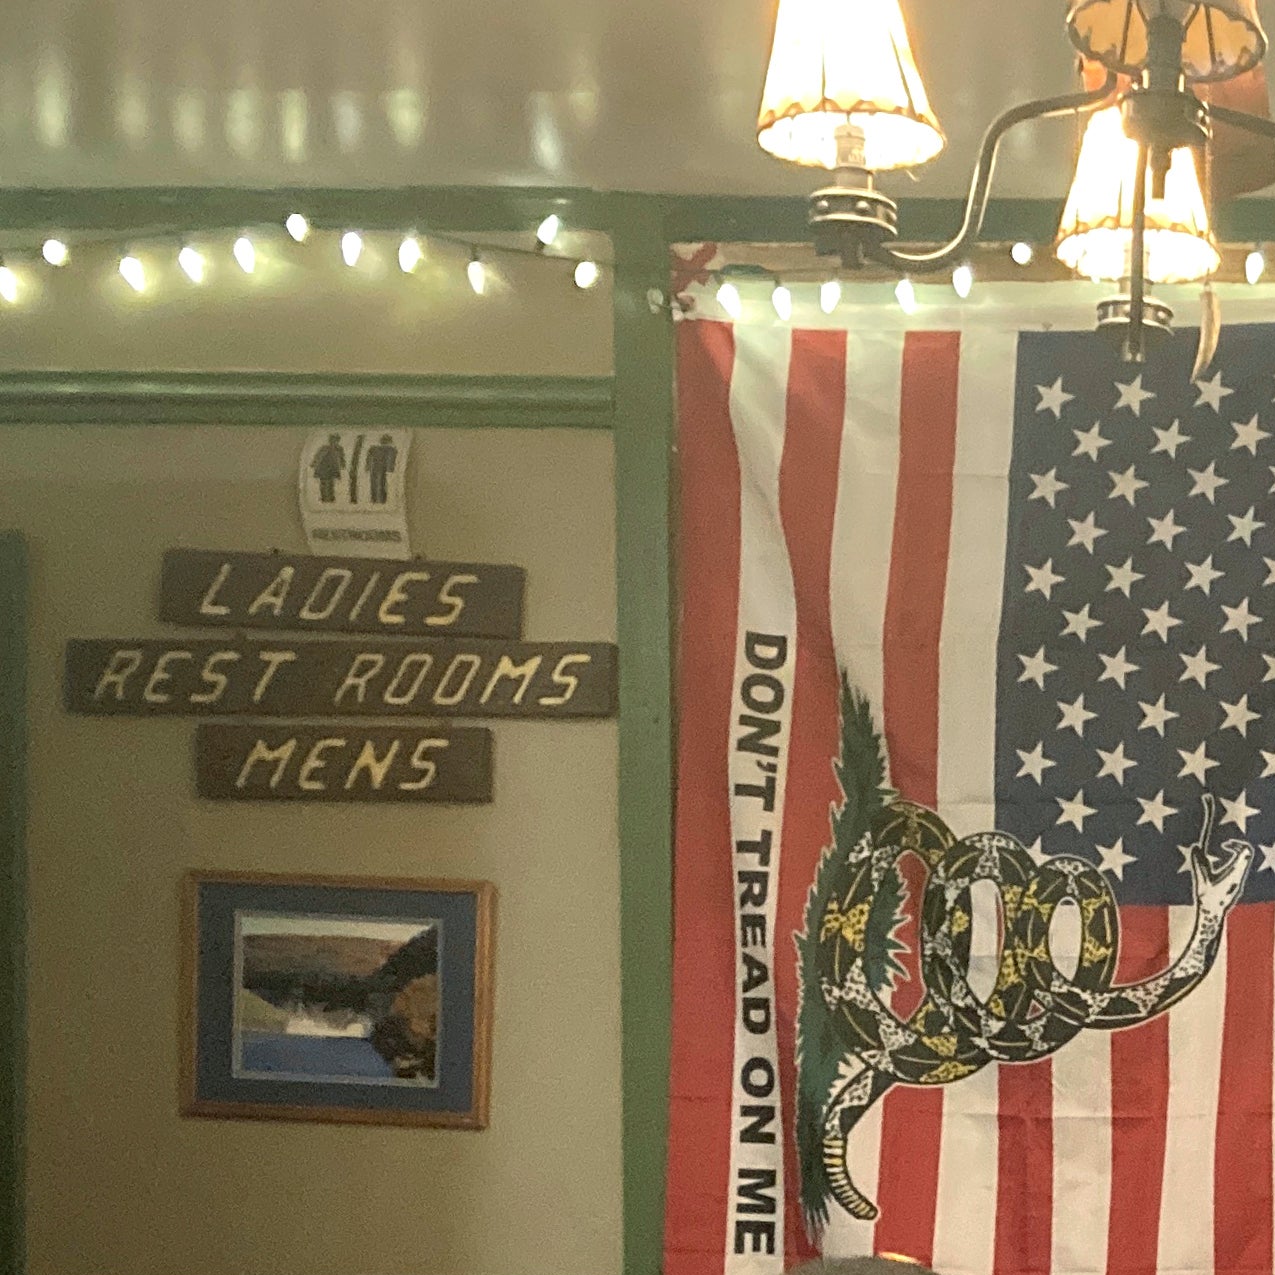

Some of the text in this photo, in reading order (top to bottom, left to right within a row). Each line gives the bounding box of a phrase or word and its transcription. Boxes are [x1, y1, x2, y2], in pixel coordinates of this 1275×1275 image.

[199, 563, 481, 626] LADIES
[95, 650, 592, 706] REST ROOMS
[235, 737, 452, 792] MENS
[732, 630, 788, 1257] DON'T TREAD ON ME
